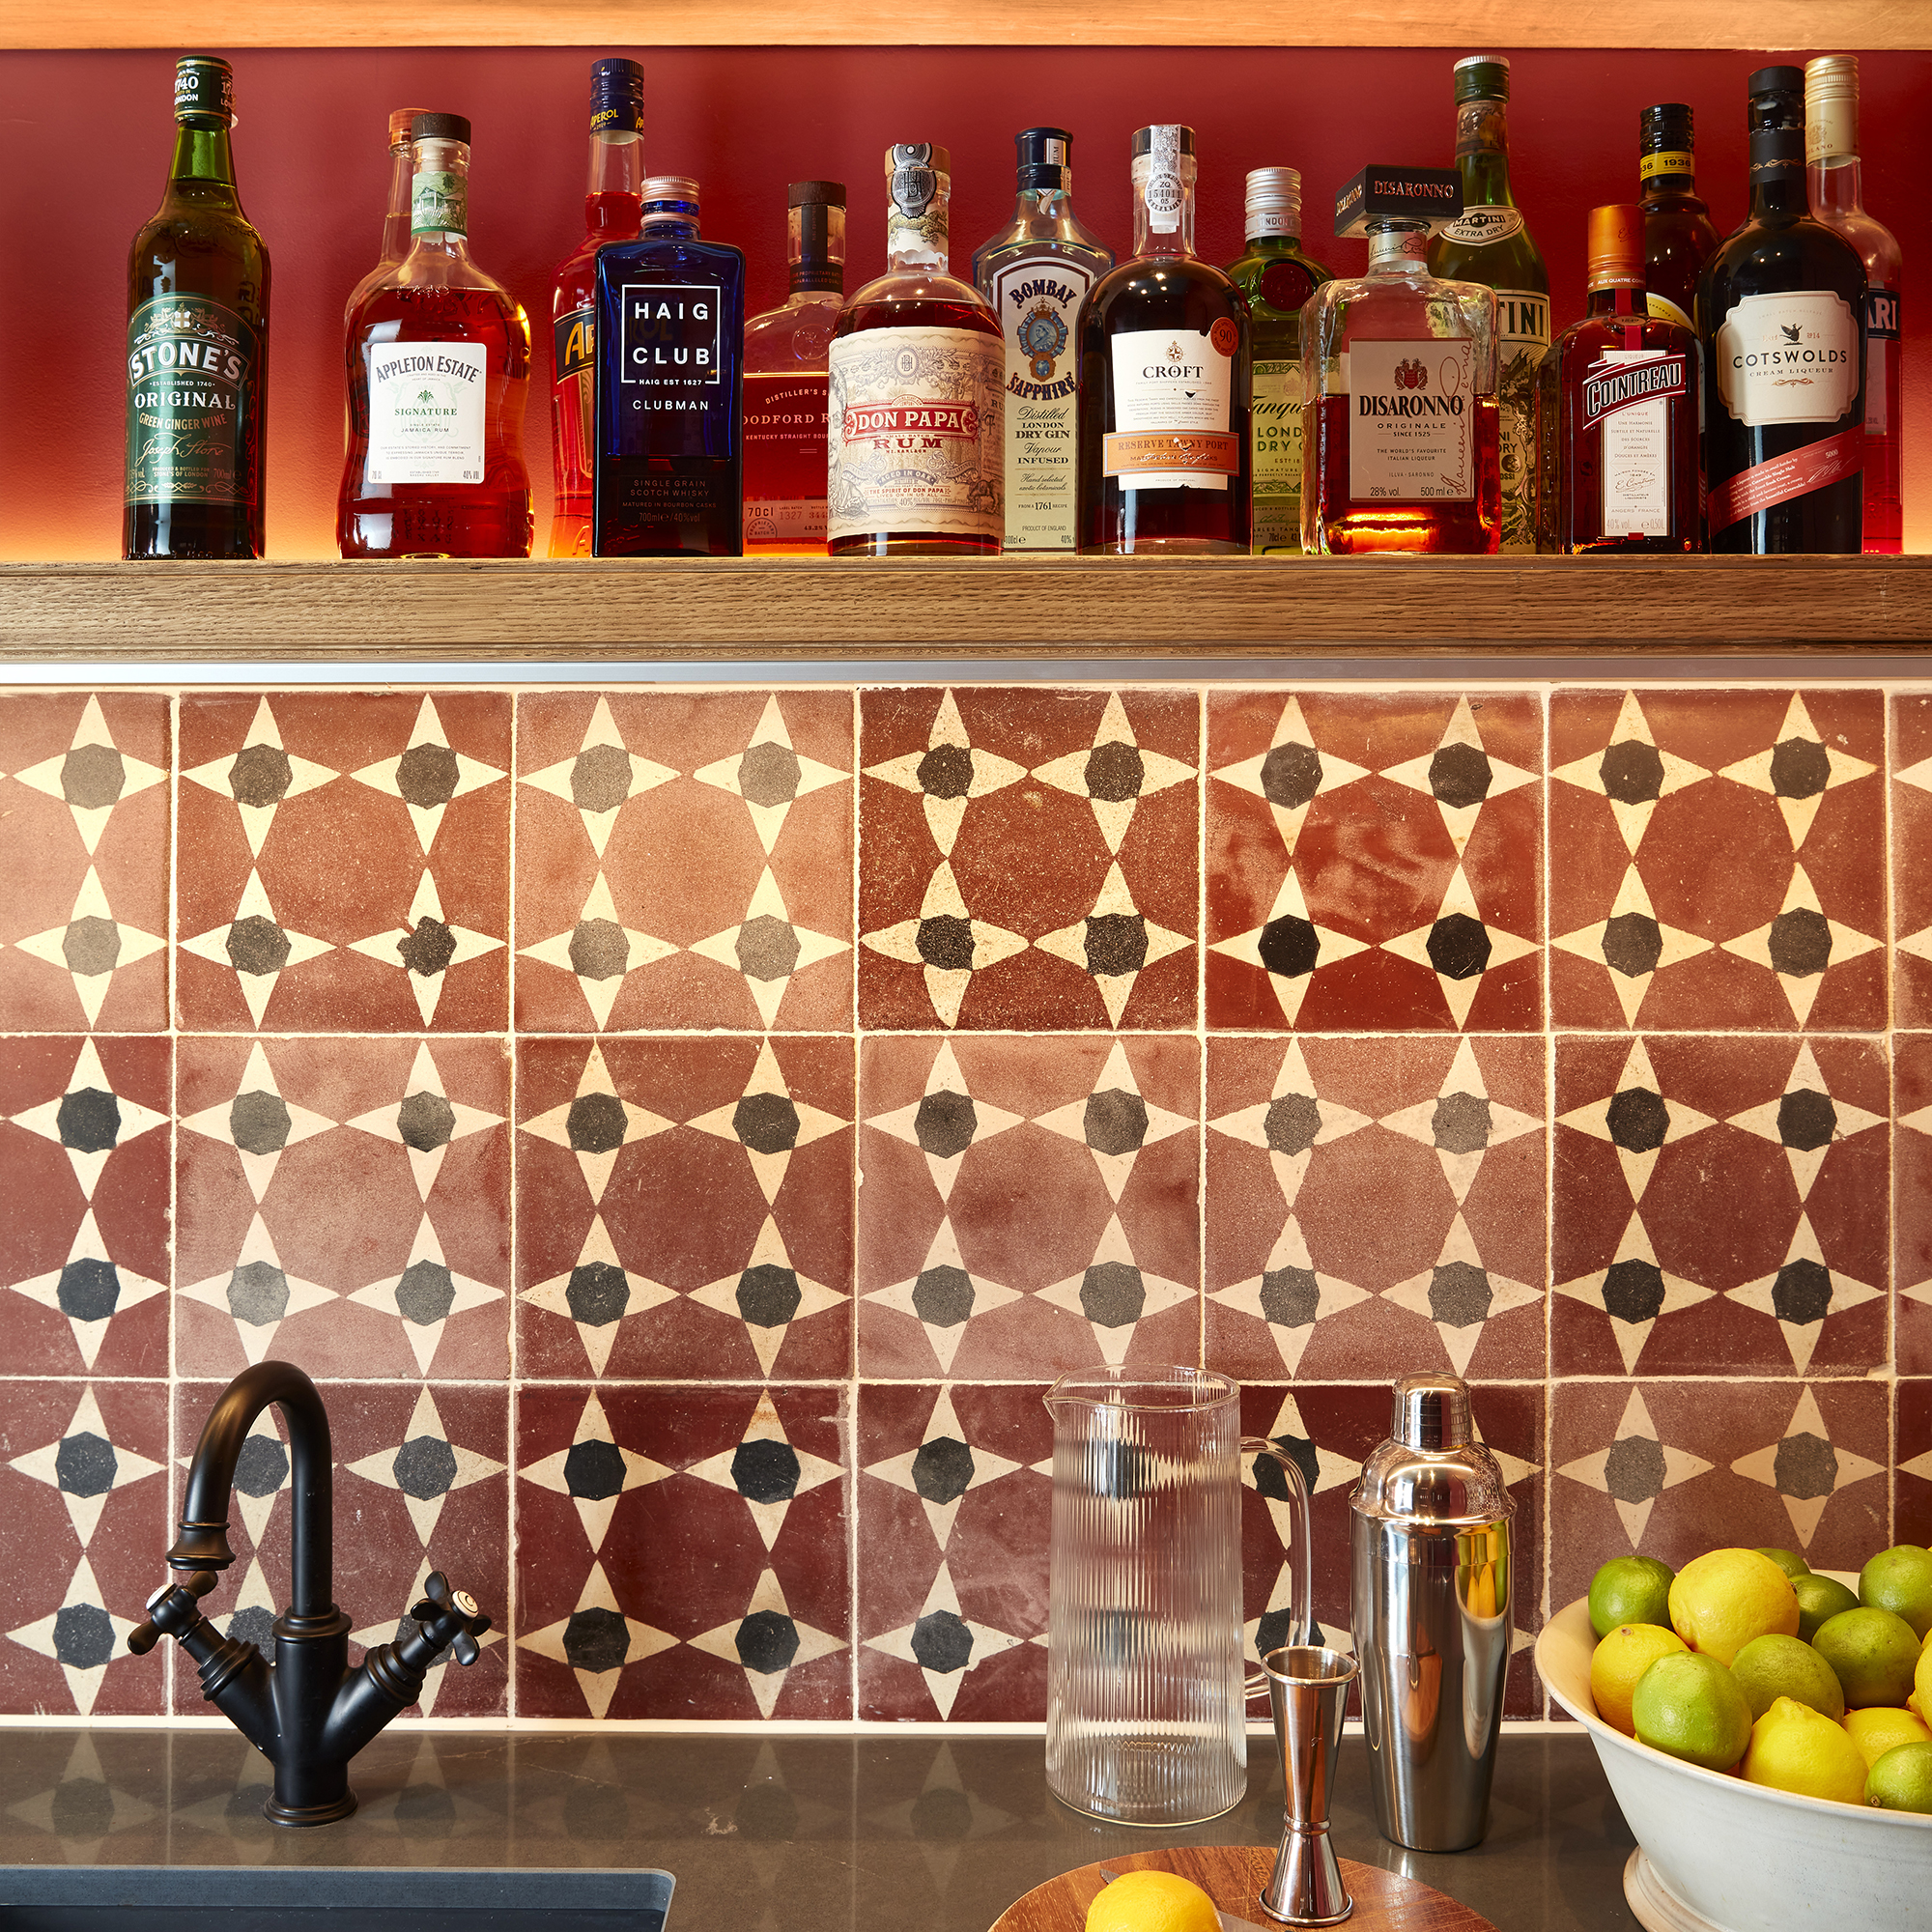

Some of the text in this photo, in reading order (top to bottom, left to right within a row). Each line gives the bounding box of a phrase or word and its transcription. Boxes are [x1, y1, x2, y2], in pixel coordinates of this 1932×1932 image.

[590, 108, 619, 130] APEROL
[1374, 180, 1455, 199] DISARONNO
[1454, 214, 1505, 227] MARTINI
[1454, 224, 1504, 237] EXTRA DRY
[1009, 278, 1077, 309] BOMBAY
[635, 302, 709, 321] HAIG
[1219, 328, 1233, 344] 90
[130, 341, 242, 381] STONE'S
[632, 347, 710, 365] CLUB
[1733, 349, 1847, 369] COTSWOLDS
[376, 355, 480, 384] APPLETON ESTATE
[1142, 365, 1205, 379] CROFT
[1749, 369, 1783, 378] CREAM
[1006, 371, 1076, 401] SAPPHIRE
[1586, 362, 1682, 417] COINTREAU
[134, 391, 237, 411] ORIGINAL
[765, 388, 818, 405] DISTILLER'S
[394, 408, 458, 416] SIGNATURE
[632, 399, 709, 411] CLUBMAN
[1359, 395, 1464, 418] DISARONNO
[1016, 406, 1070, 420] Distilled
[138, 412, 228, 431] GREEN GINGER WINE
[858, 411, 960, 431] DON PAPA
[1014, 430, 1070, 440] DRY GIN
[1258, 426, 1302, 438] LOND
[873, 438, 944, 450] RUM
[1023, 441, 1063, 456] Vapour
[1118, 439, 1164, 451] RESERVE
[1205, 440, 1230, 450] PORT
[1258, 440, 1292, 452] DRY
[880, 470, 901, 482] AGED
[915, 470, 932, 481] OAK
[1020, 473, 1040, 483] Hand
[1370, 487, 1387, 497] 28%
[1420, 487, 1435, 497] 500
[1435, 487, 1446, 497] ml
[748, 506, 774, 517] 70cl
[1035, 501, 1053, 511] 1761
[779, 511, 803, 521] 1327
